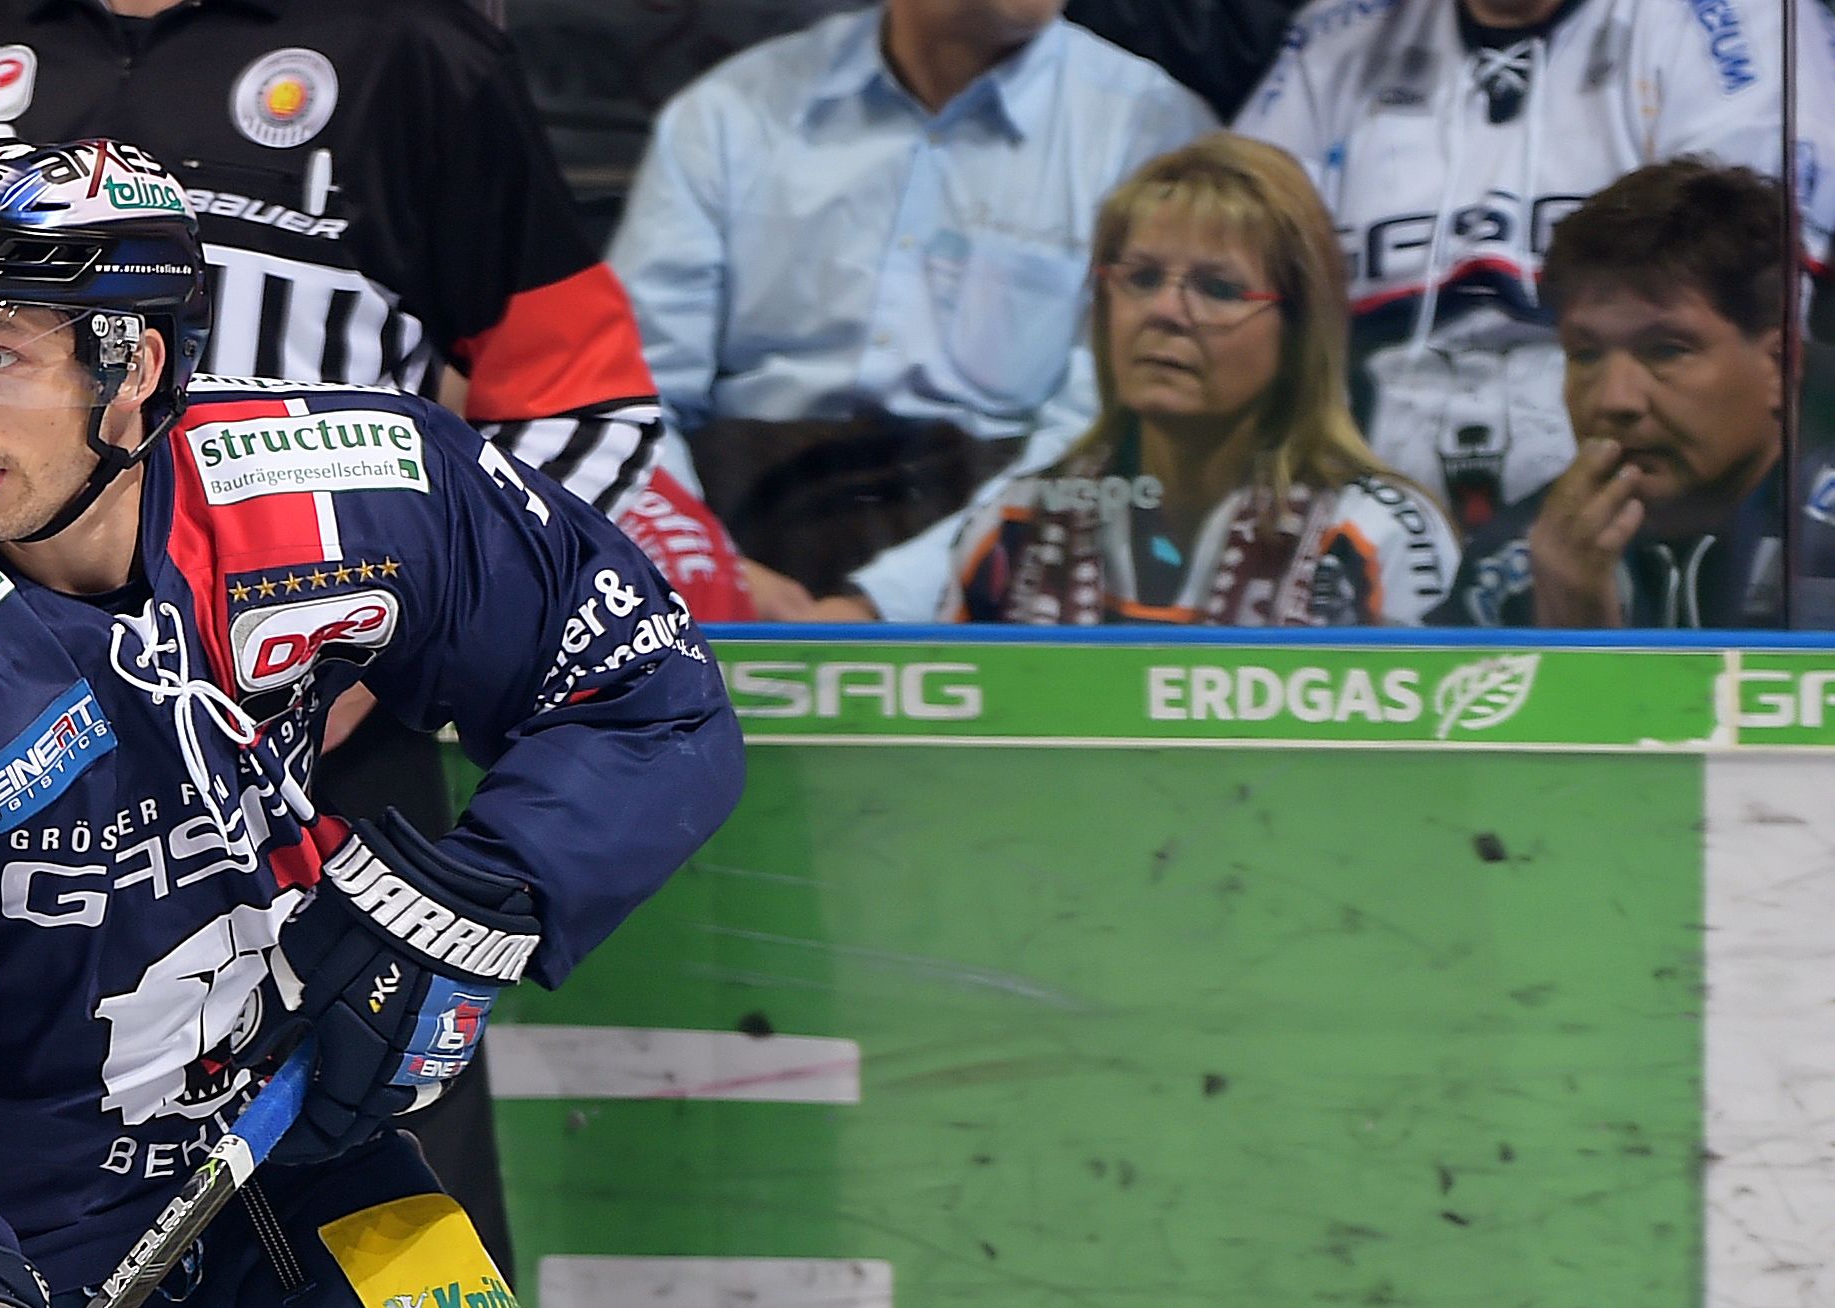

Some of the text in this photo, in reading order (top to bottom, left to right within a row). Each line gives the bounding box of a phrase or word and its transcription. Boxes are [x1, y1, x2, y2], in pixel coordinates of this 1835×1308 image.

[103, 174, 187, 212] tolina
[201, 419, 413, 468] structure
[211, 460, 397, 495] Bauträgergesellschaft
[594, 569, 645, 618] &
[1148, 666, 1424, 723] ERDGAS
